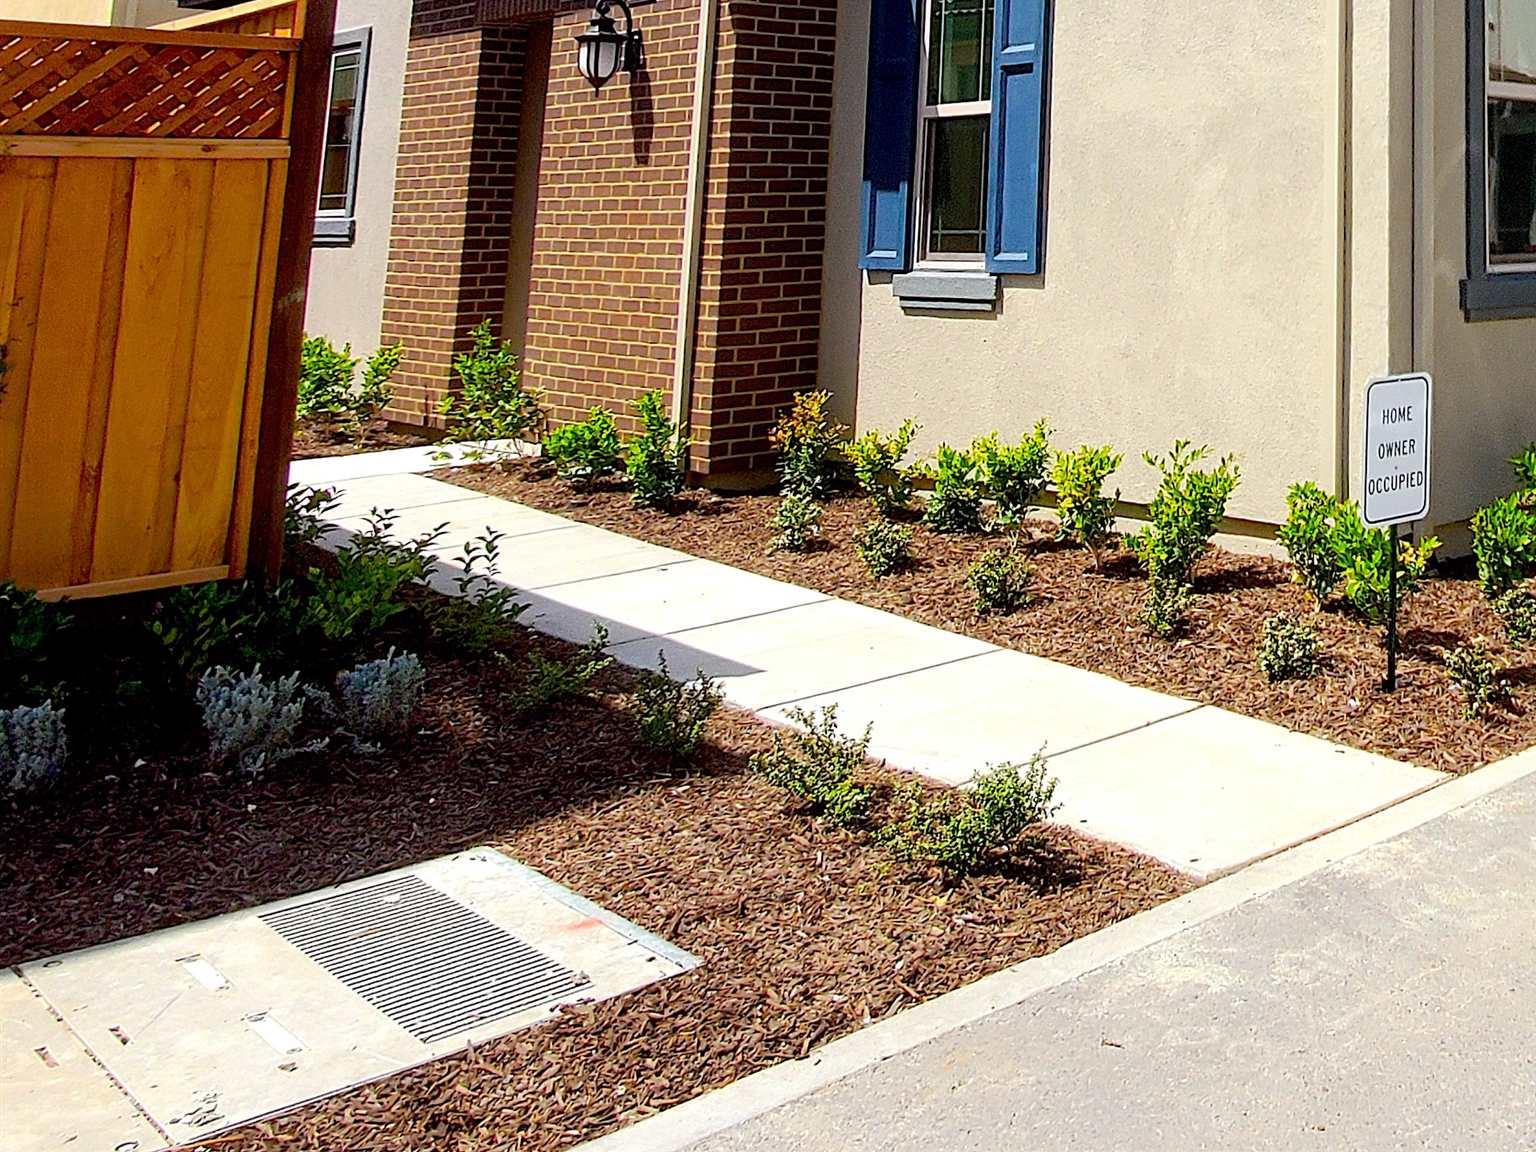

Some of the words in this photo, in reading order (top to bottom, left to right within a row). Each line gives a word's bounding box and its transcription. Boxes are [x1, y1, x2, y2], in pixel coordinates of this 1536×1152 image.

[1382, 406, 1413, 425] HOME
[1378, 438, 1416, 459] OWNER
[1368, 470, 1423, 495] OCCUPIED
